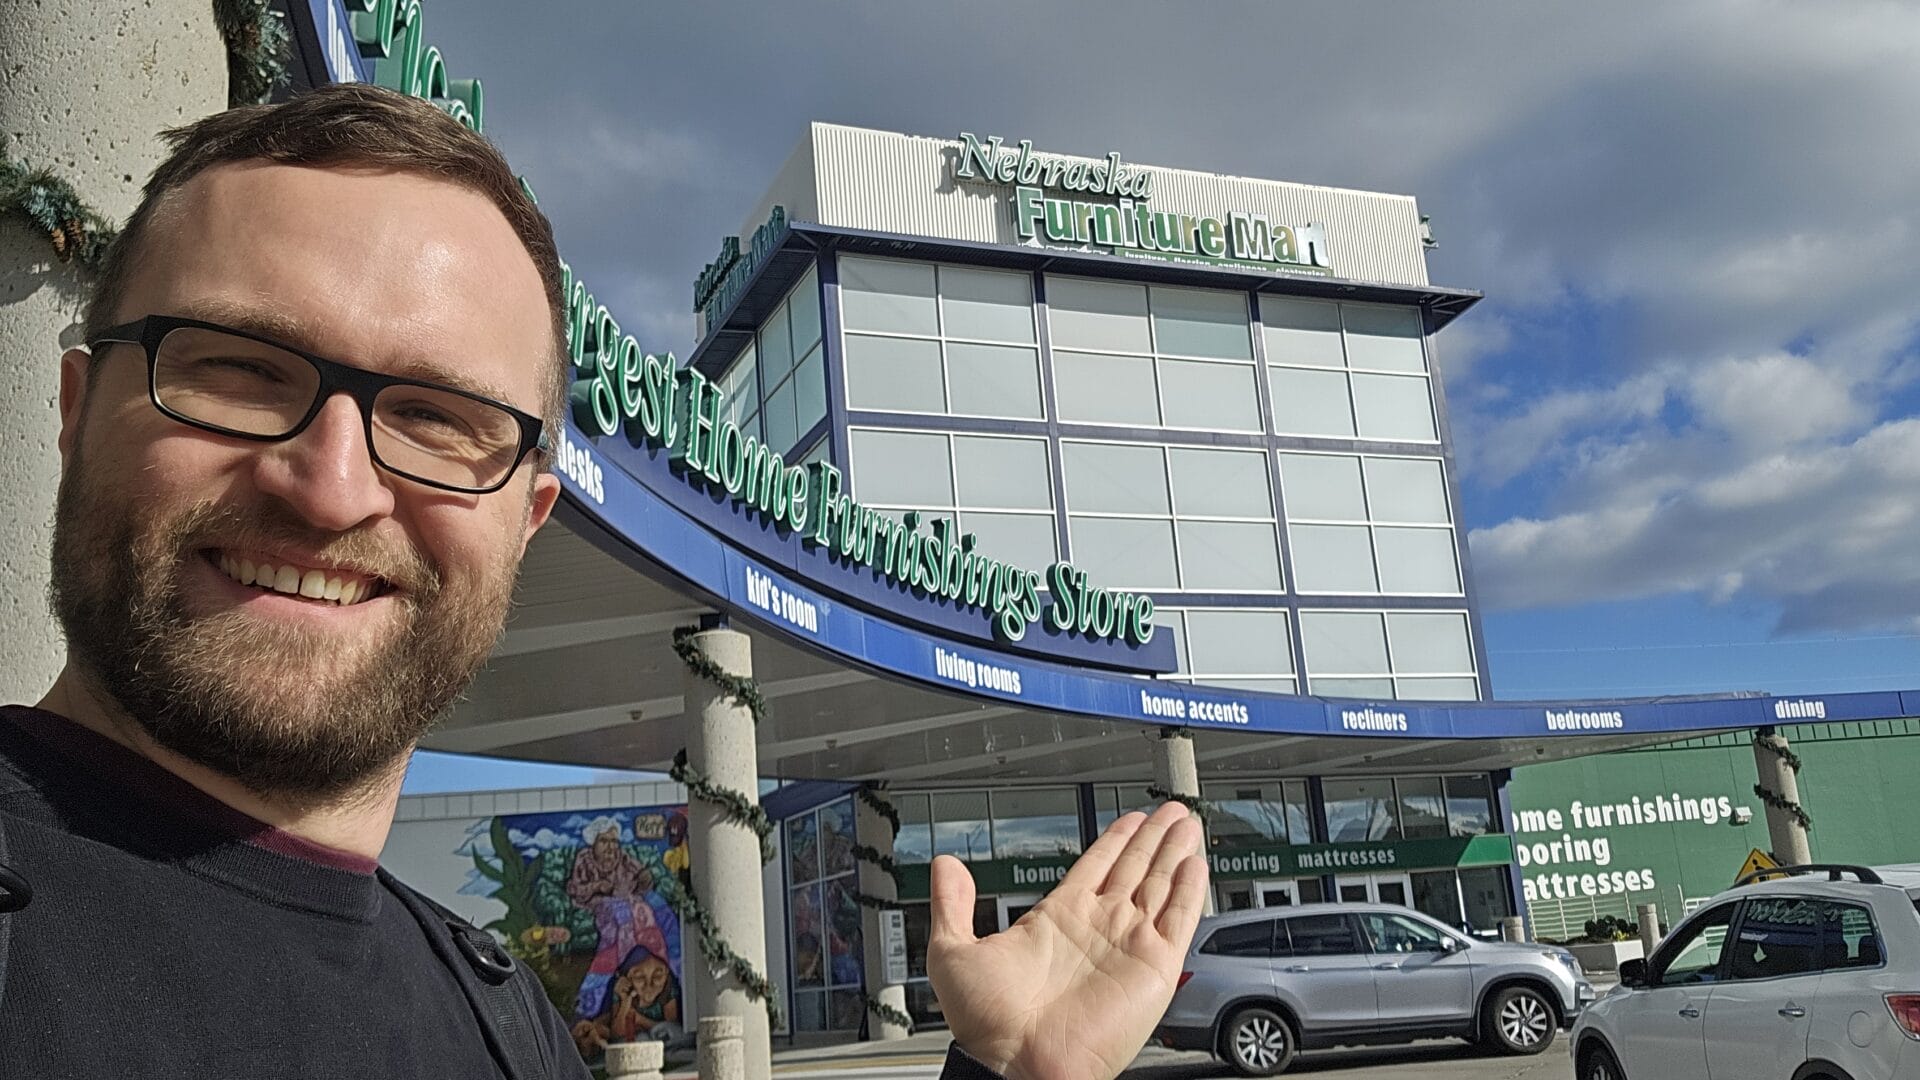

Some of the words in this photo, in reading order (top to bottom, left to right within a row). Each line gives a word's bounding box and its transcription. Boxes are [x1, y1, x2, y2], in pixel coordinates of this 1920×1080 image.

[958, 132, 1154, 198] Nebraska
[1016, 186, 1226, 257] Furniture
[559, 257, 679, 449] rgest
[686, 366, 808, 532] Home
[815, 460, 1040, 641] Furnishings
[1053, 561, 1154, 644] Store
[746, 566, 781, 615] kid's
[781, 590, 817, 633] room
[935, 647, 977, 688] living
[977, 662, 1021, 695] rooms
[1140, 689, 1186, 719] home
[1188, 699, 1249, 724] accents
[1342, 708, 1407, 732] recliners
[1546, 710, 1623, 731] bedrooms
[1774, 699, 1826, 719] dining
[1511, 808, 1563, 833] me
[1571, 793, 1732, 829] furnishings
[1208, 850, 1280, 874] looring
[1297, 849, 1396, 868] mattresses
[1516, 833, 1611, 866] ooring
[1013, 864, 1067, 884] home
[1522, 868, 1656, 901] attresses
